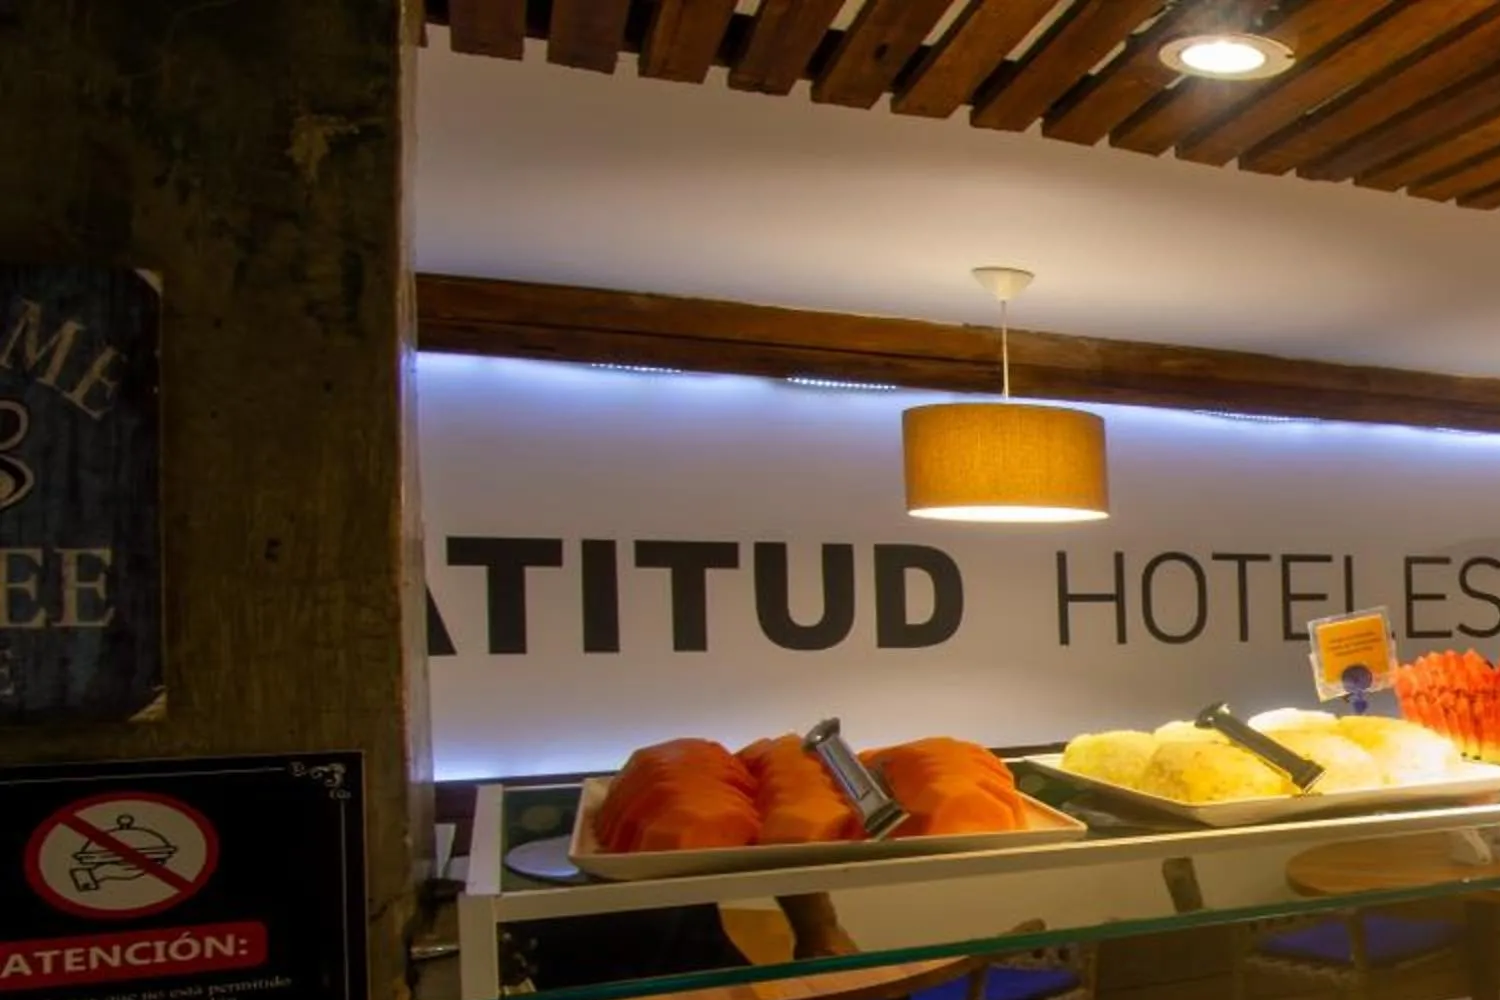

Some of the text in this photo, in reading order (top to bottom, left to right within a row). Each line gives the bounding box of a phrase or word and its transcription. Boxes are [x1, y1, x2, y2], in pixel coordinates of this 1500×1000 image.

[426, 535, 964, 656] TITUD
[1, 932, 249, 979] ATENCIÓN:
[207, 974, 293, 997] permitido
